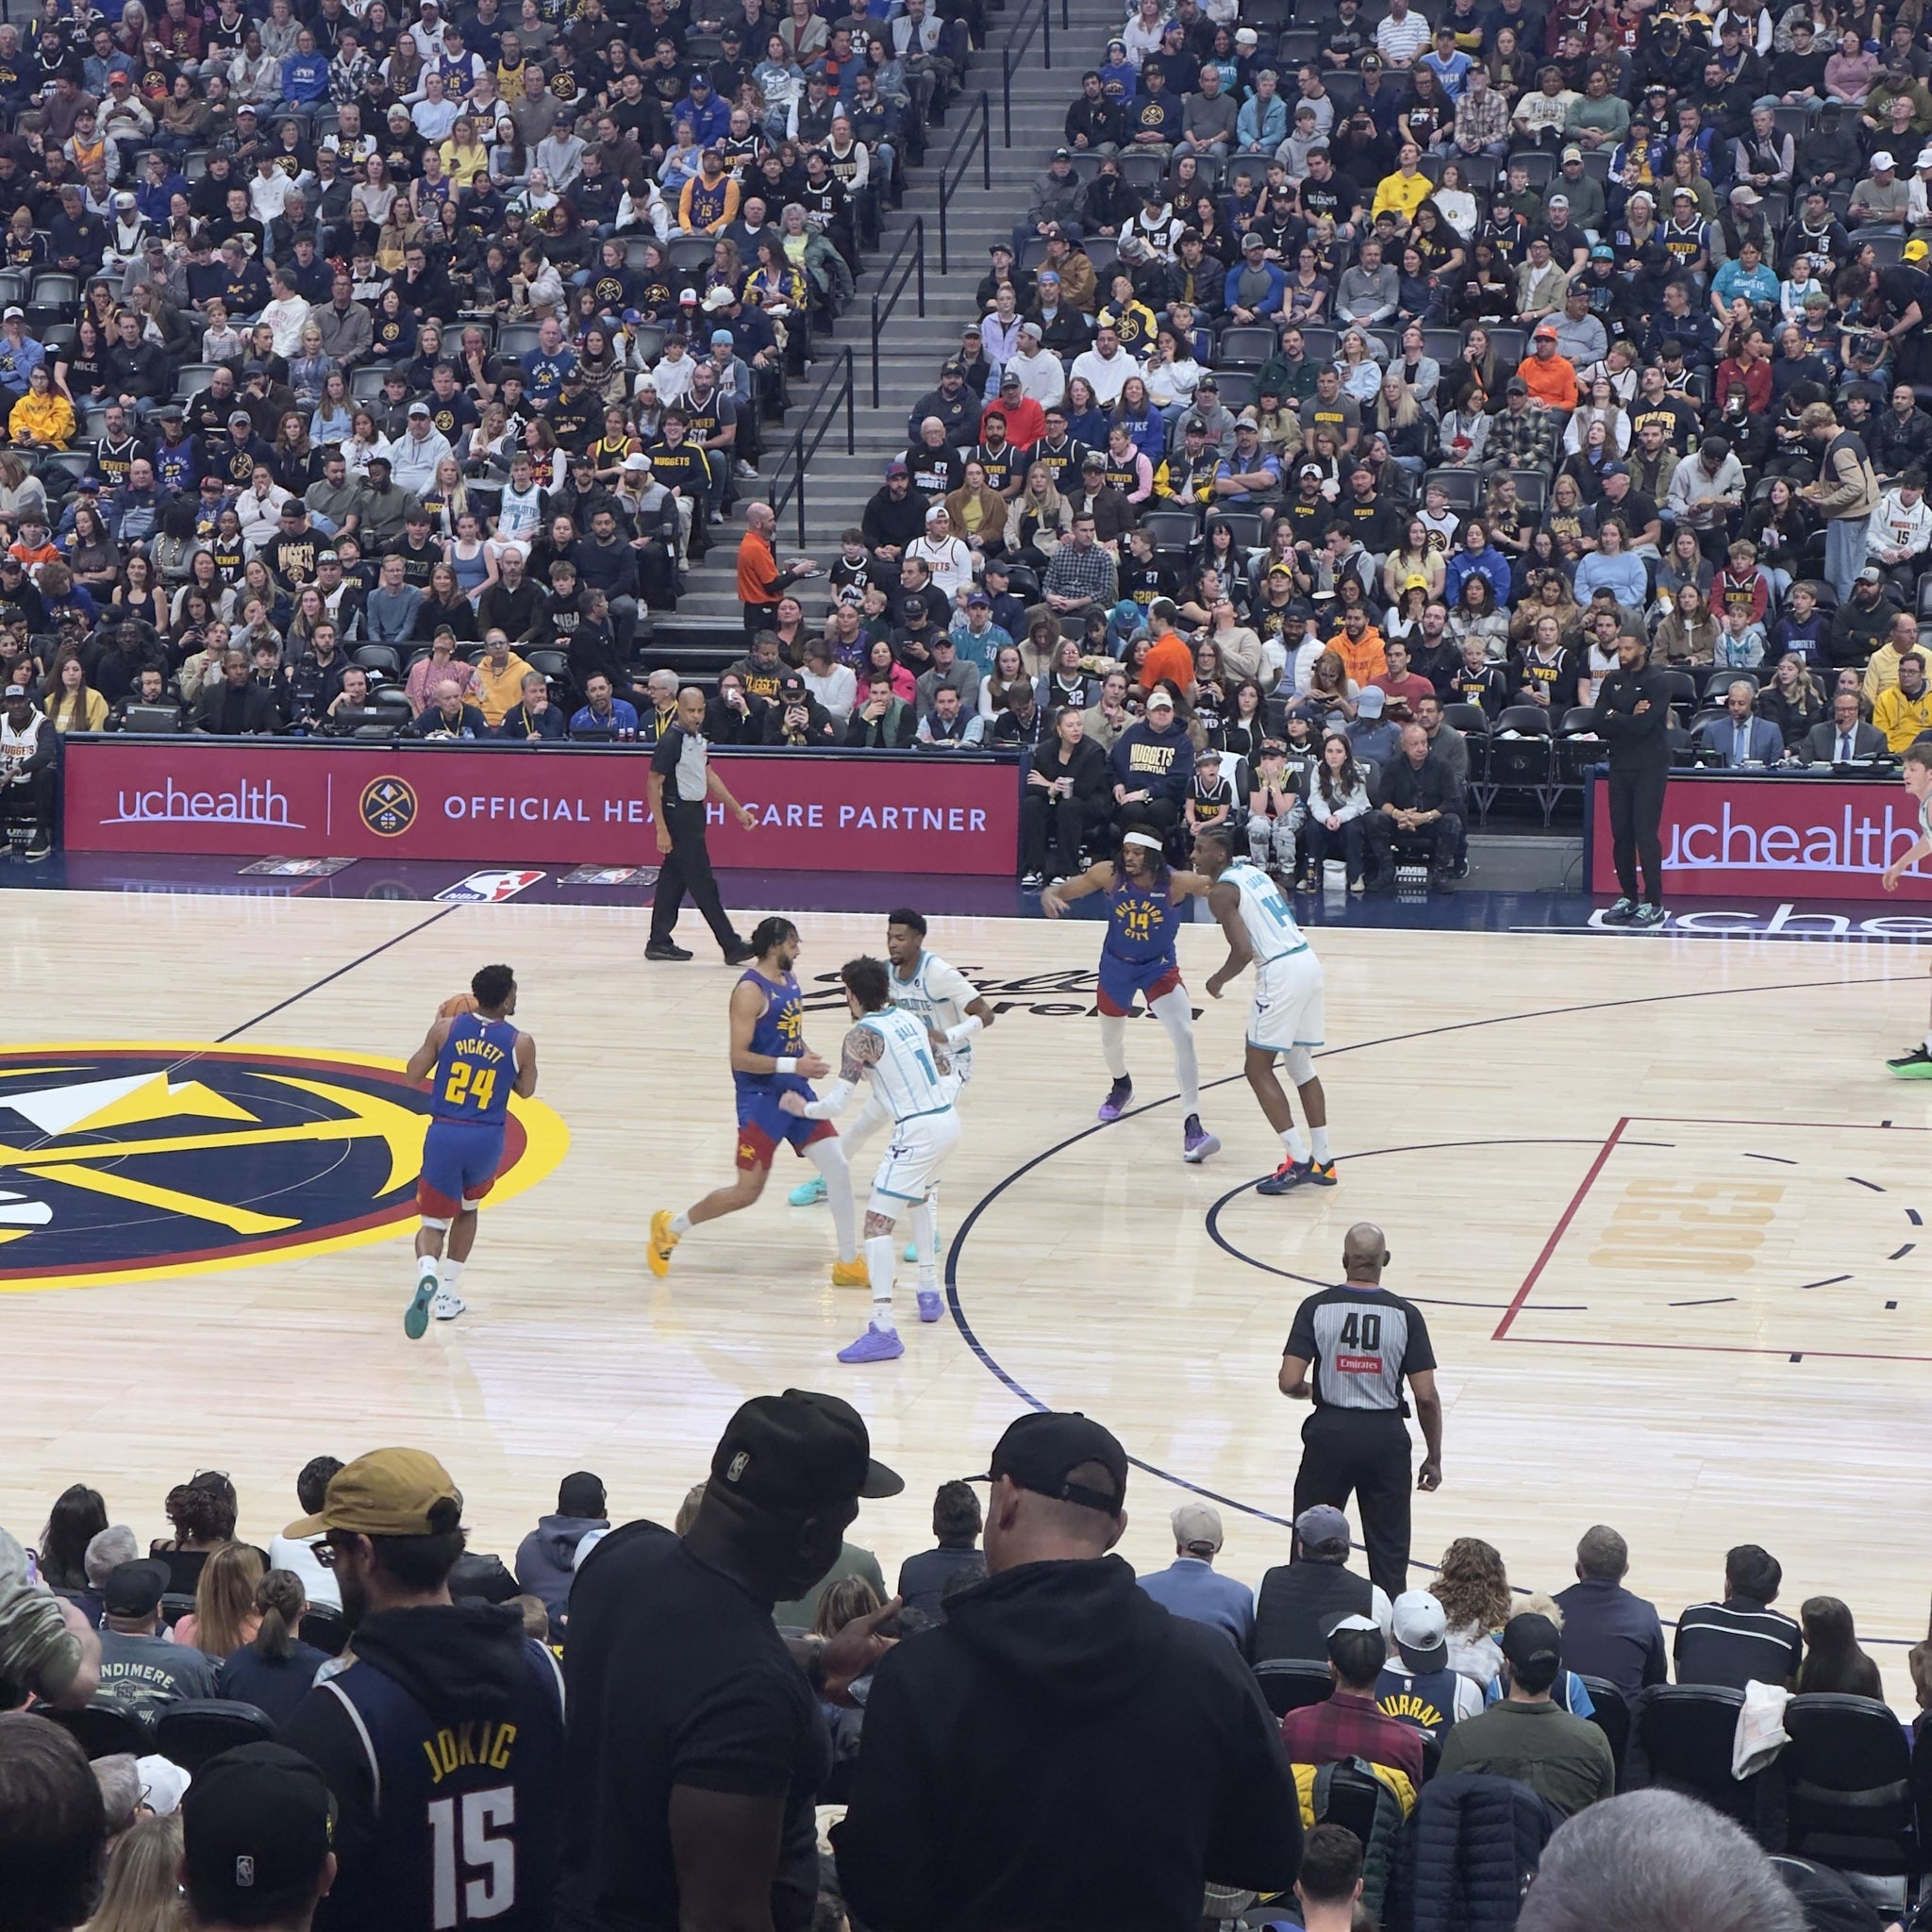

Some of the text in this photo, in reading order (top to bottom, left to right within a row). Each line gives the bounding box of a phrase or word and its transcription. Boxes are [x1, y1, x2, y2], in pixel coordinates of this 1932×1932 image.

[1624, 30, 1637, 43] 15
[701, 204, 713, 217] 15
[823, 196, 832, 209] 15
[1154, 232, 1168, 247] 32
[74, 359, 99, 374] NICE
[655, 456, 691, 467] NUGGETS
[107, 472, 124, 484] 15
[164, 465, 181, 476] 27
[503, 506, 540, 517] CHARLOTTE
[511, 513, 521, 530] 1
[1896, 530, 1910, 546] 15
[278, 545, 315, 573] NUGGETS
[854, 573, 868, 586] 27
[1146, 571, 1158, 583] 27
[986, 646, 998, 660] 30
[745, 675, 781, 695] NUGGET
[1463, 683, 1486, 692] DENVER
[1068, 690, 1084, 706] 32
[1, 744, 34, 756] NUGGETS
[1129, 742, 1175, 767] NUGGETS
[118, 776, 289, 822] uchealth
[443, 795, 591, 822] OFFICIAL
[604, 799, 724, 825] HEH
[839, 805, 988, 833] PARTNER
[1395, 866, 1428, 876] UMB
[446, 892, 481, 903] NBA
[1115, 899, 1165, 923] MILE HIGH
[1261, 893, 1297, 928] 14
[1128, 911, 1149, 929] 14
[1124, 927, 1150, 941] CITY
[894, 1023, 918, 1041] BALL
[456, 1039, 505, 1063] PICKETT
[914, 1048, 937, 1087] 1
[445, 1060, 497, 1111] 24
[1588, 1179, 1787, 1274] 5280
[1340, 1312, 1381, 1351] 40
[1340, 1357, 1378, 1371] Emirates
[101, 1662, 175, 1690] NDIMERE
[423, 1721, 518, 1784] JOKIC
[426, 1785, 515, 1930] 15
